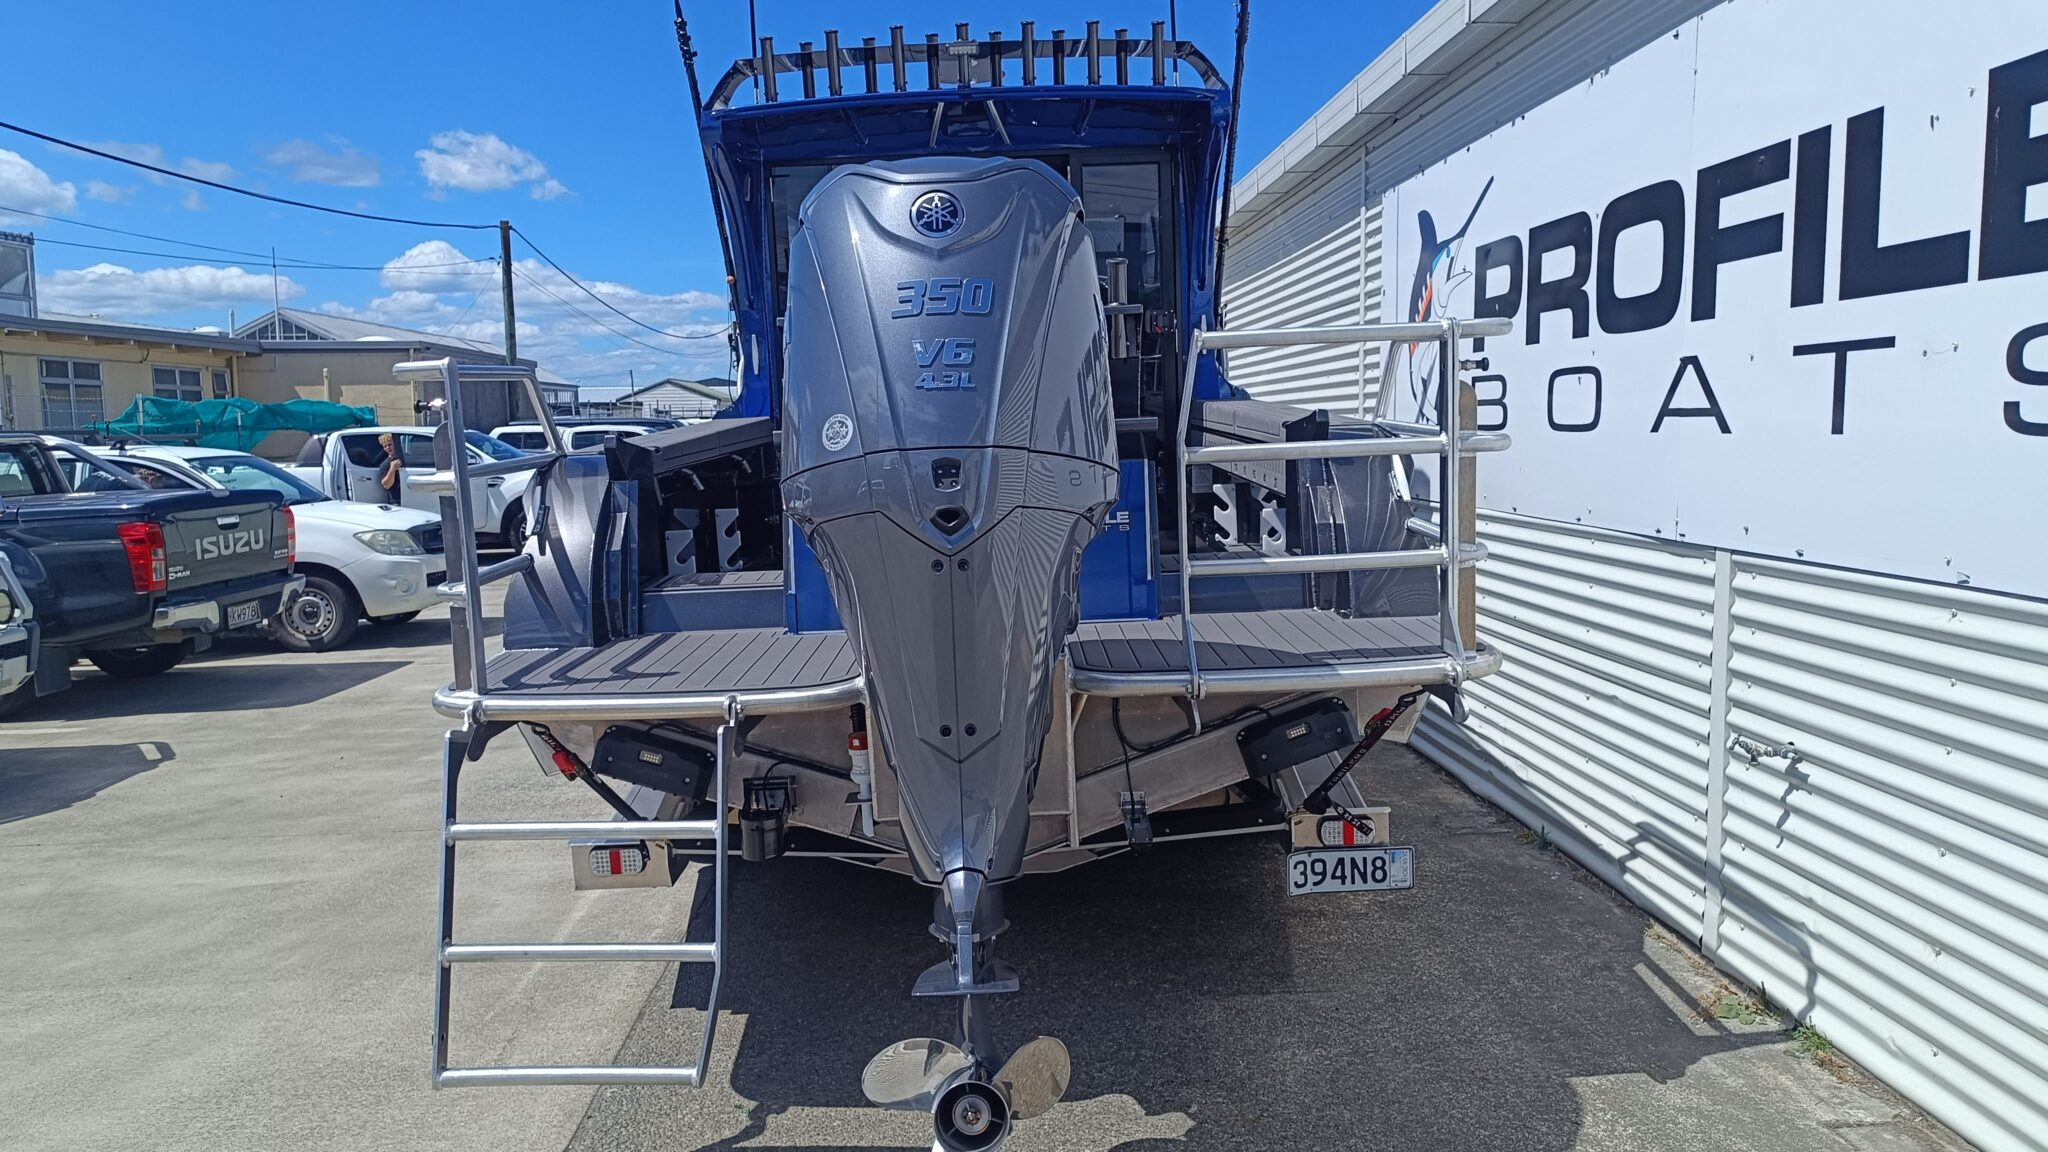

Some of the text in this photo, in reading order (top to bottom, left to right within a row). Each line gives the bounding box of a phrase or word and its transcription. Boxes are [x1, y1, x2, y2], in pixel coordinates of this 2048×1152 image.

[892, 277, 994, 318] 350
[912, 338, 976, 367] V6
[914, 372, 976, 391] 4.3L
[195, 529, 264, 560] ISUZU
[1293, 856, 1388, 889] 394N8
